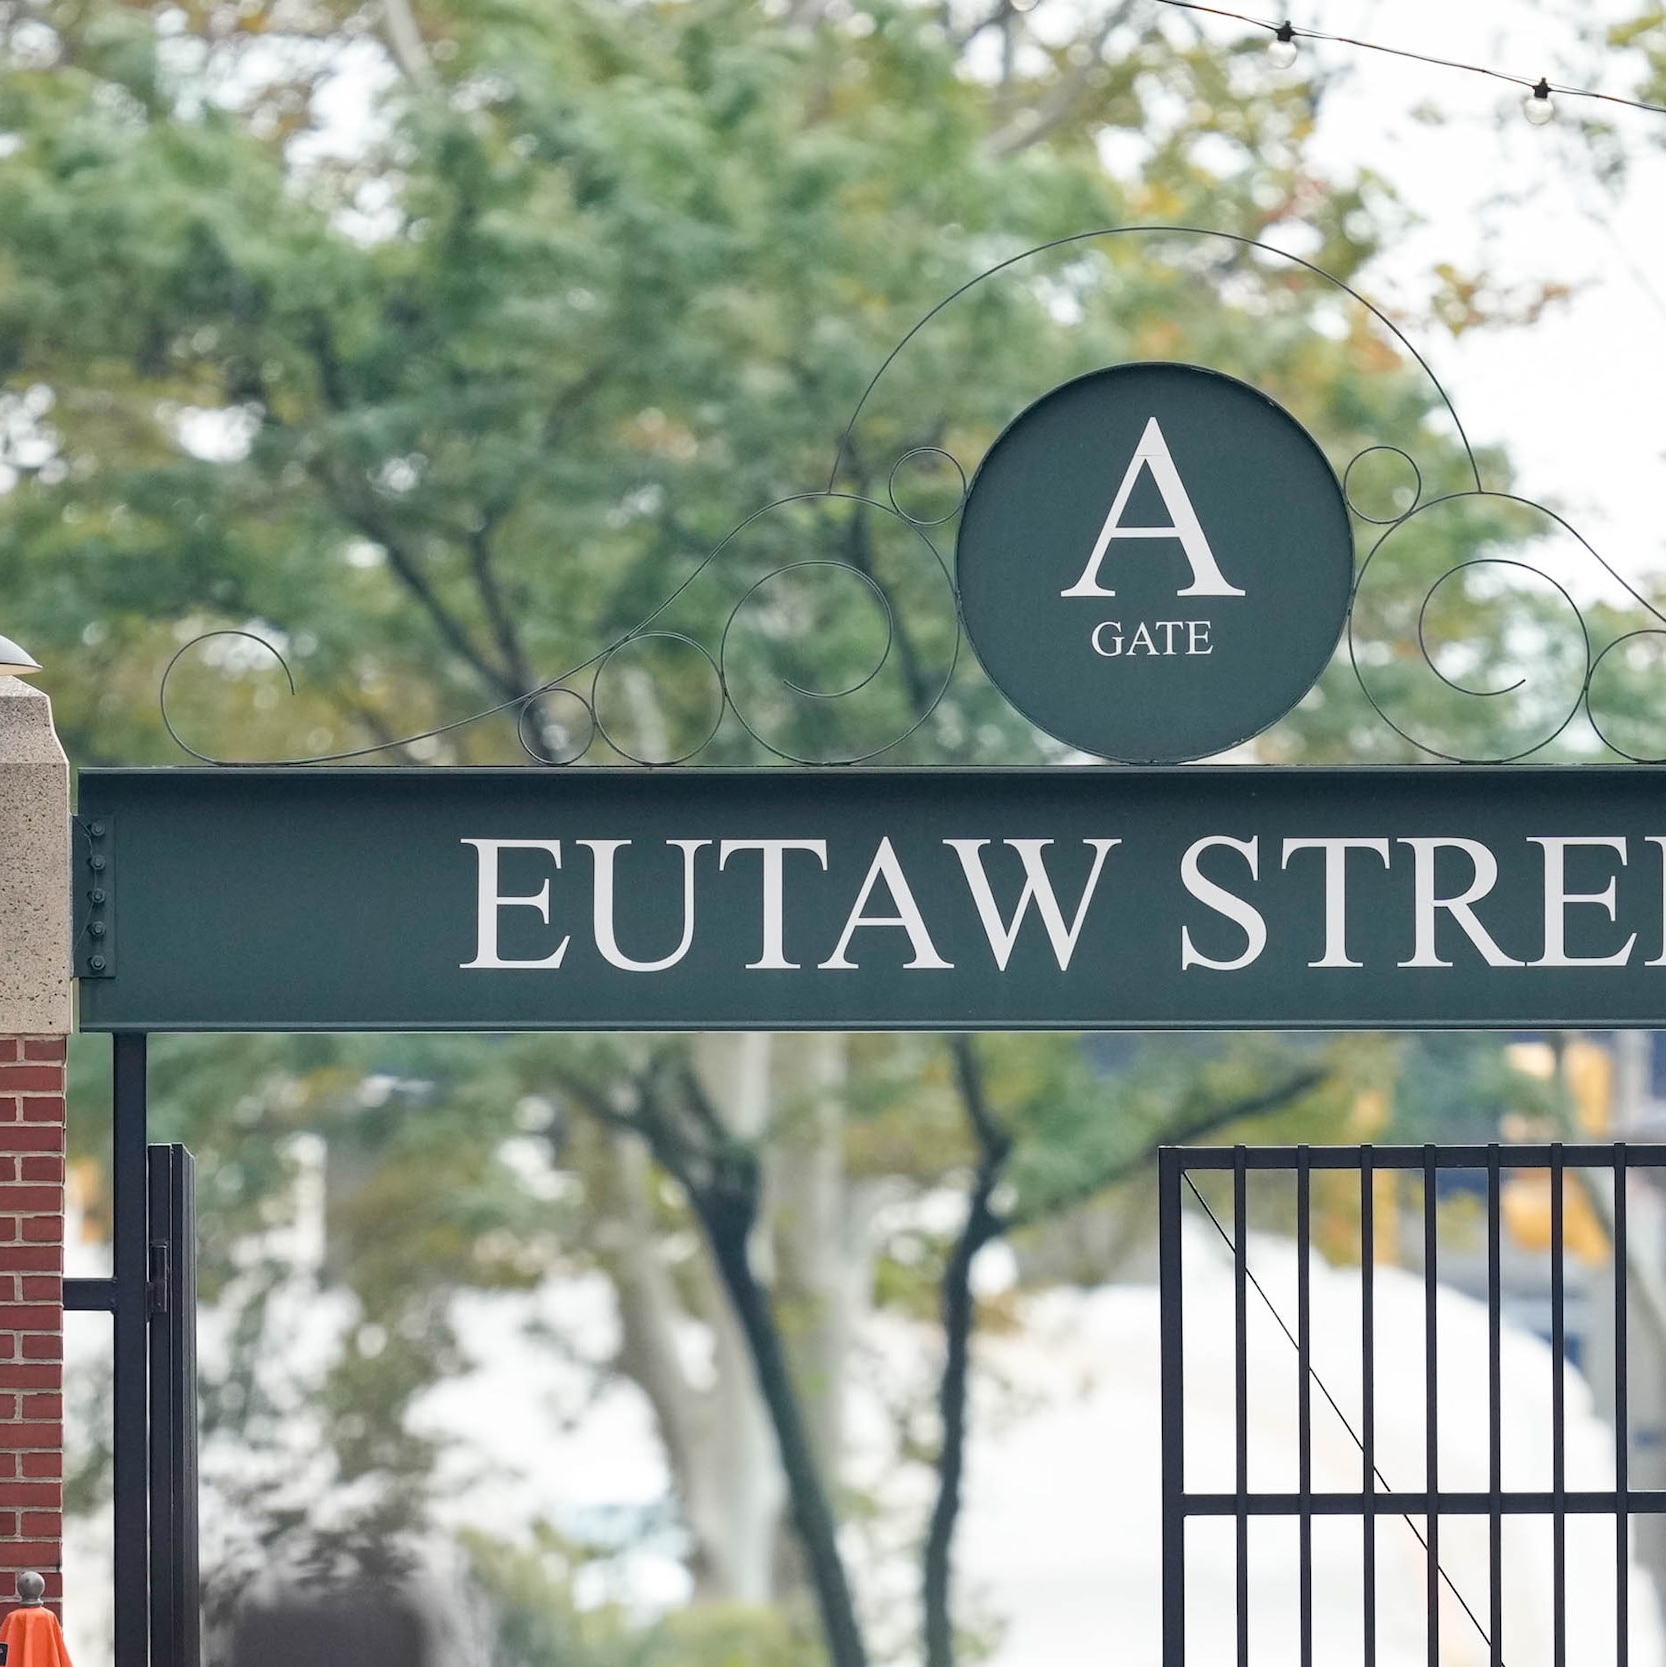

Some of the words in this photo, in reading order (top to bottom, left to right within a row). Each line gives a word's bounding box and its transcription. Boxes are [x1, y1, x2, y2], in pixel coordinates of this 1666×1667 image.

[1060, 416, 1246, 597] A
[1091, 620, 1214, 657] GATE
[459, 835, 1122, 973] EUTAW
